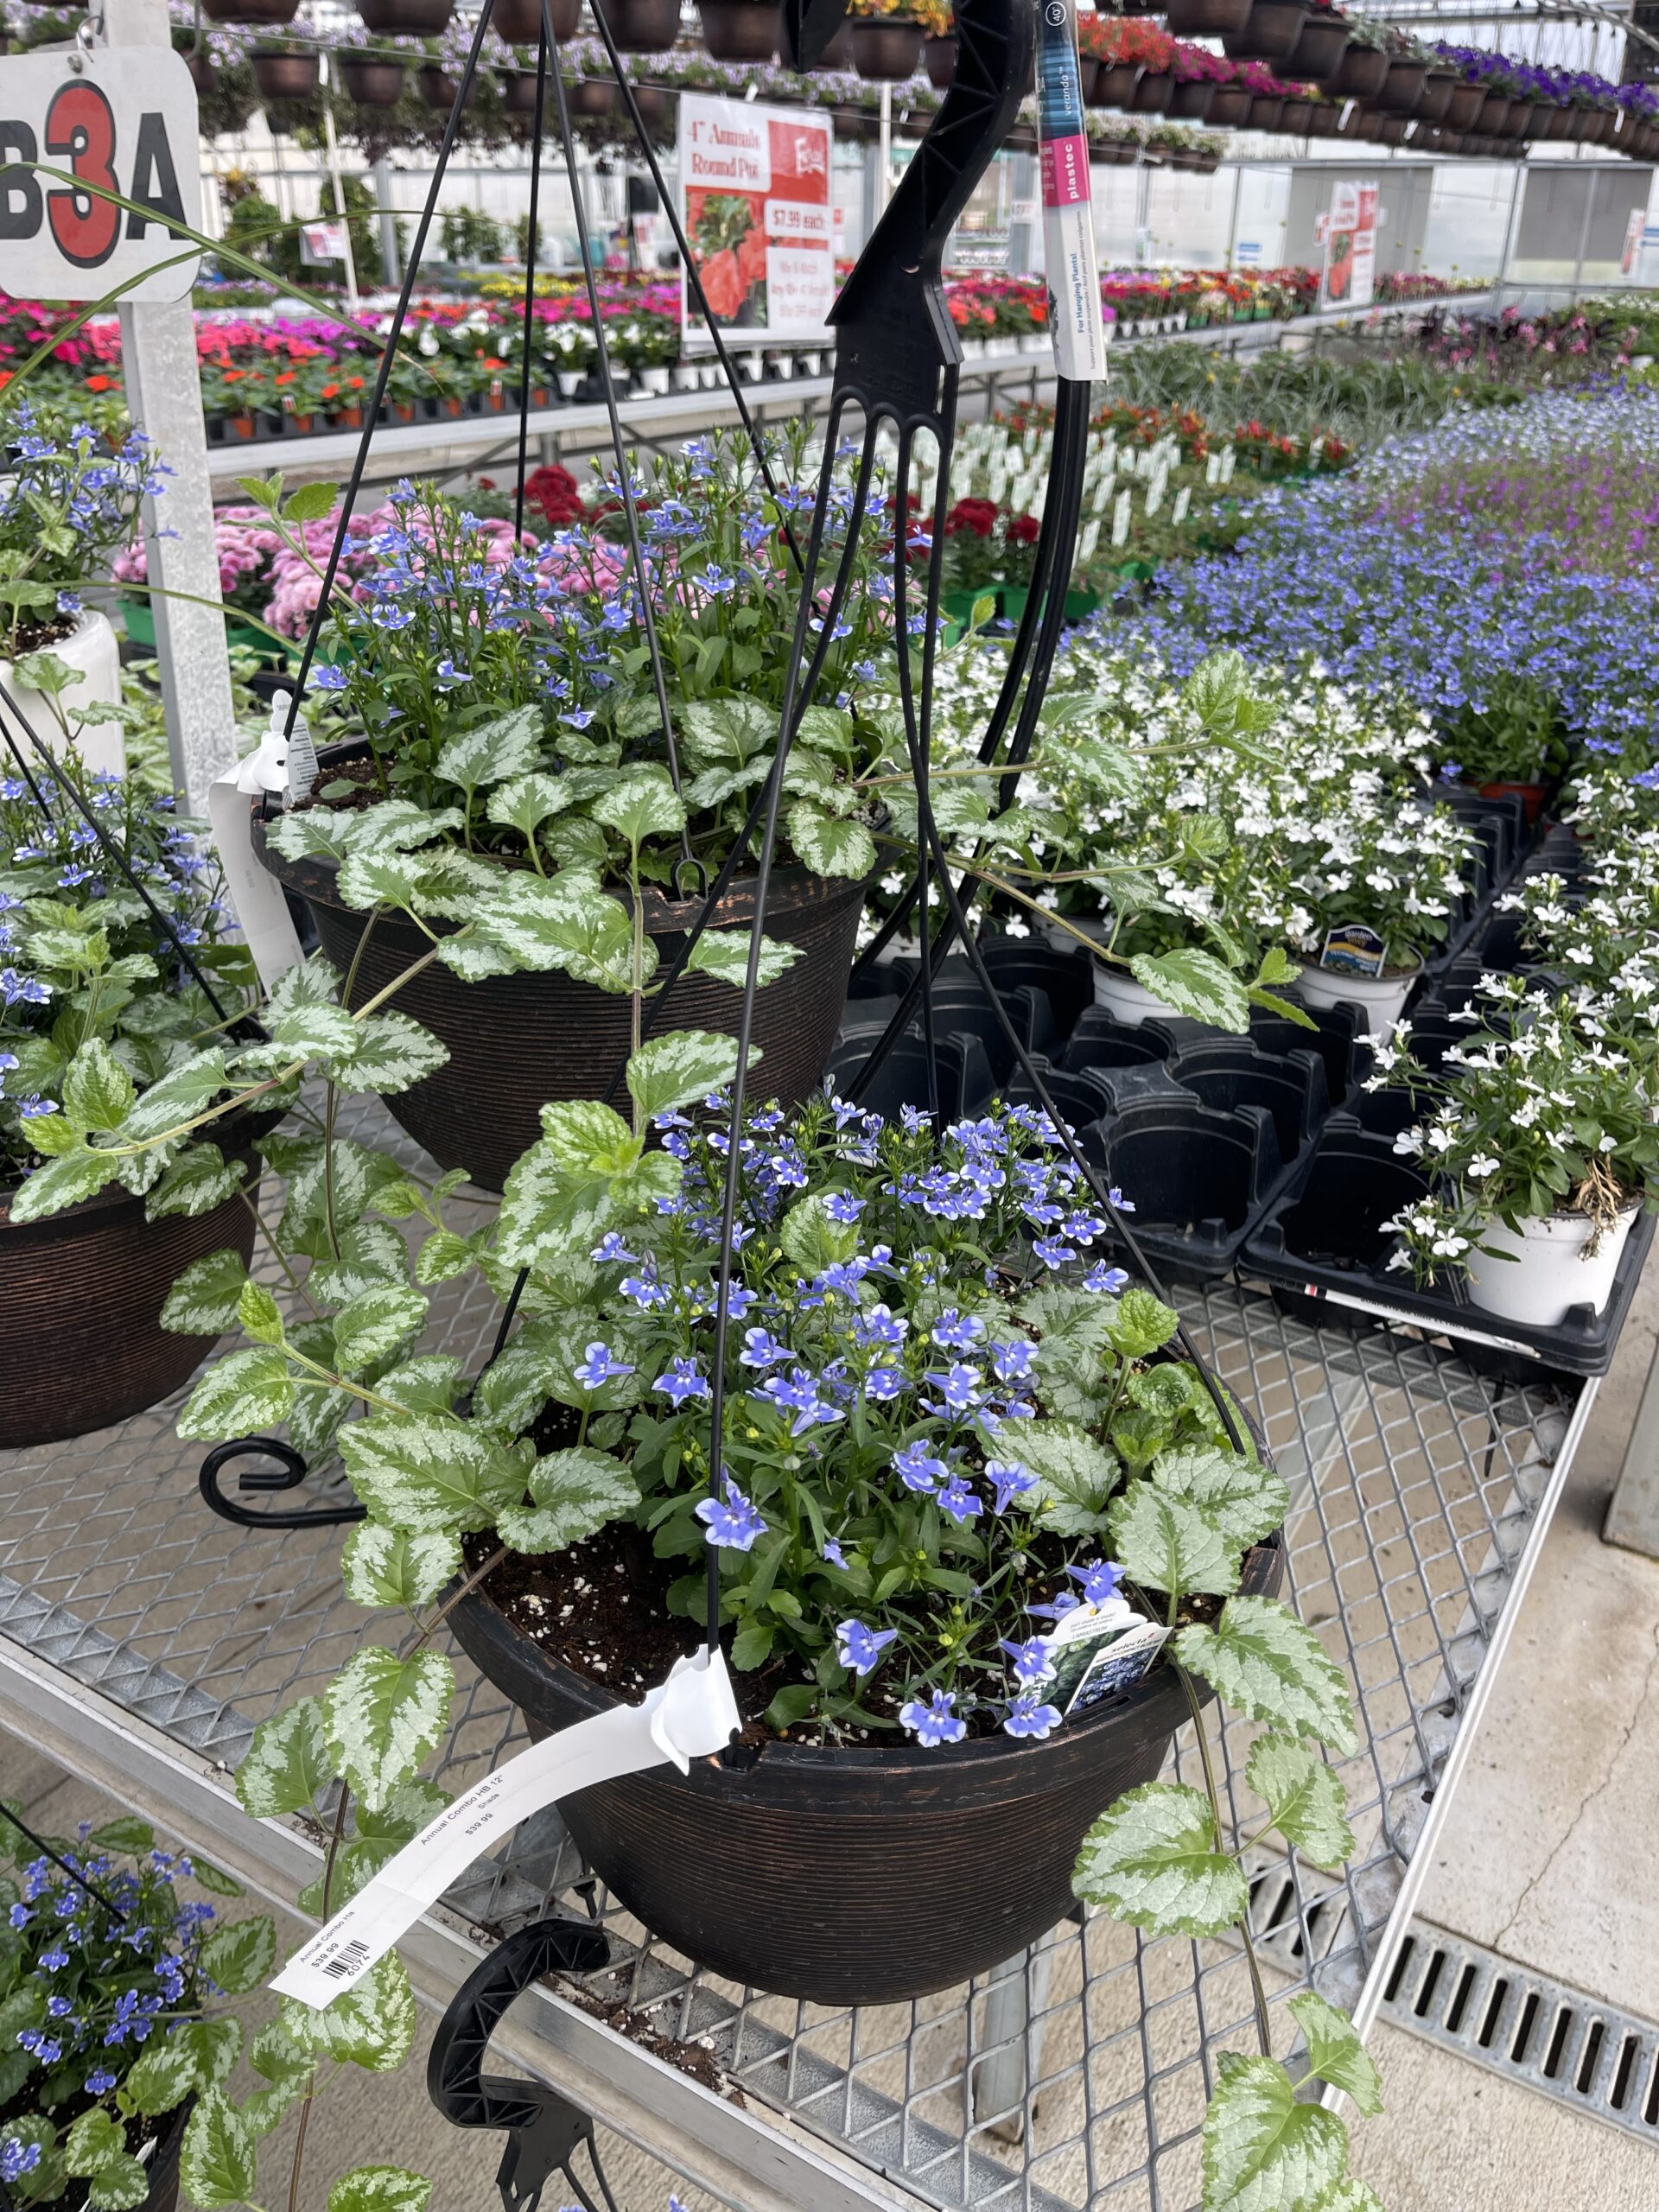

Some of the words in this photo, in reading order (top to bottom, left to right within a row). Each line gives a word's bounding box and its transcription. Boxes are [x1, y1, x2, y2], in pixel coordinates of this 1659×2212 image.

[0, 79, 190, 270] B3A
[692, 153, 736, 178] Round
[1065, 143, 1080, 200] plastec
[1070, 252, 1079, 283] Plants!
[1074, 283, 1083, 319] Hanging
[421, 1820, 449, 1846] Annual
[448, 1796, 477, 1820] Combo
[475, 1785, 491, 1797] HB
[478, 1793, 500, 1809] Shade
[465, 1813, 493, 1835] $39.99
[300, 1942, 323, 1963] Annual
[321, 1921, 345, 1942] Combo
[311, 1942, 339, 1968] $39.99
[347, 1955, 371, 1977] 6074
